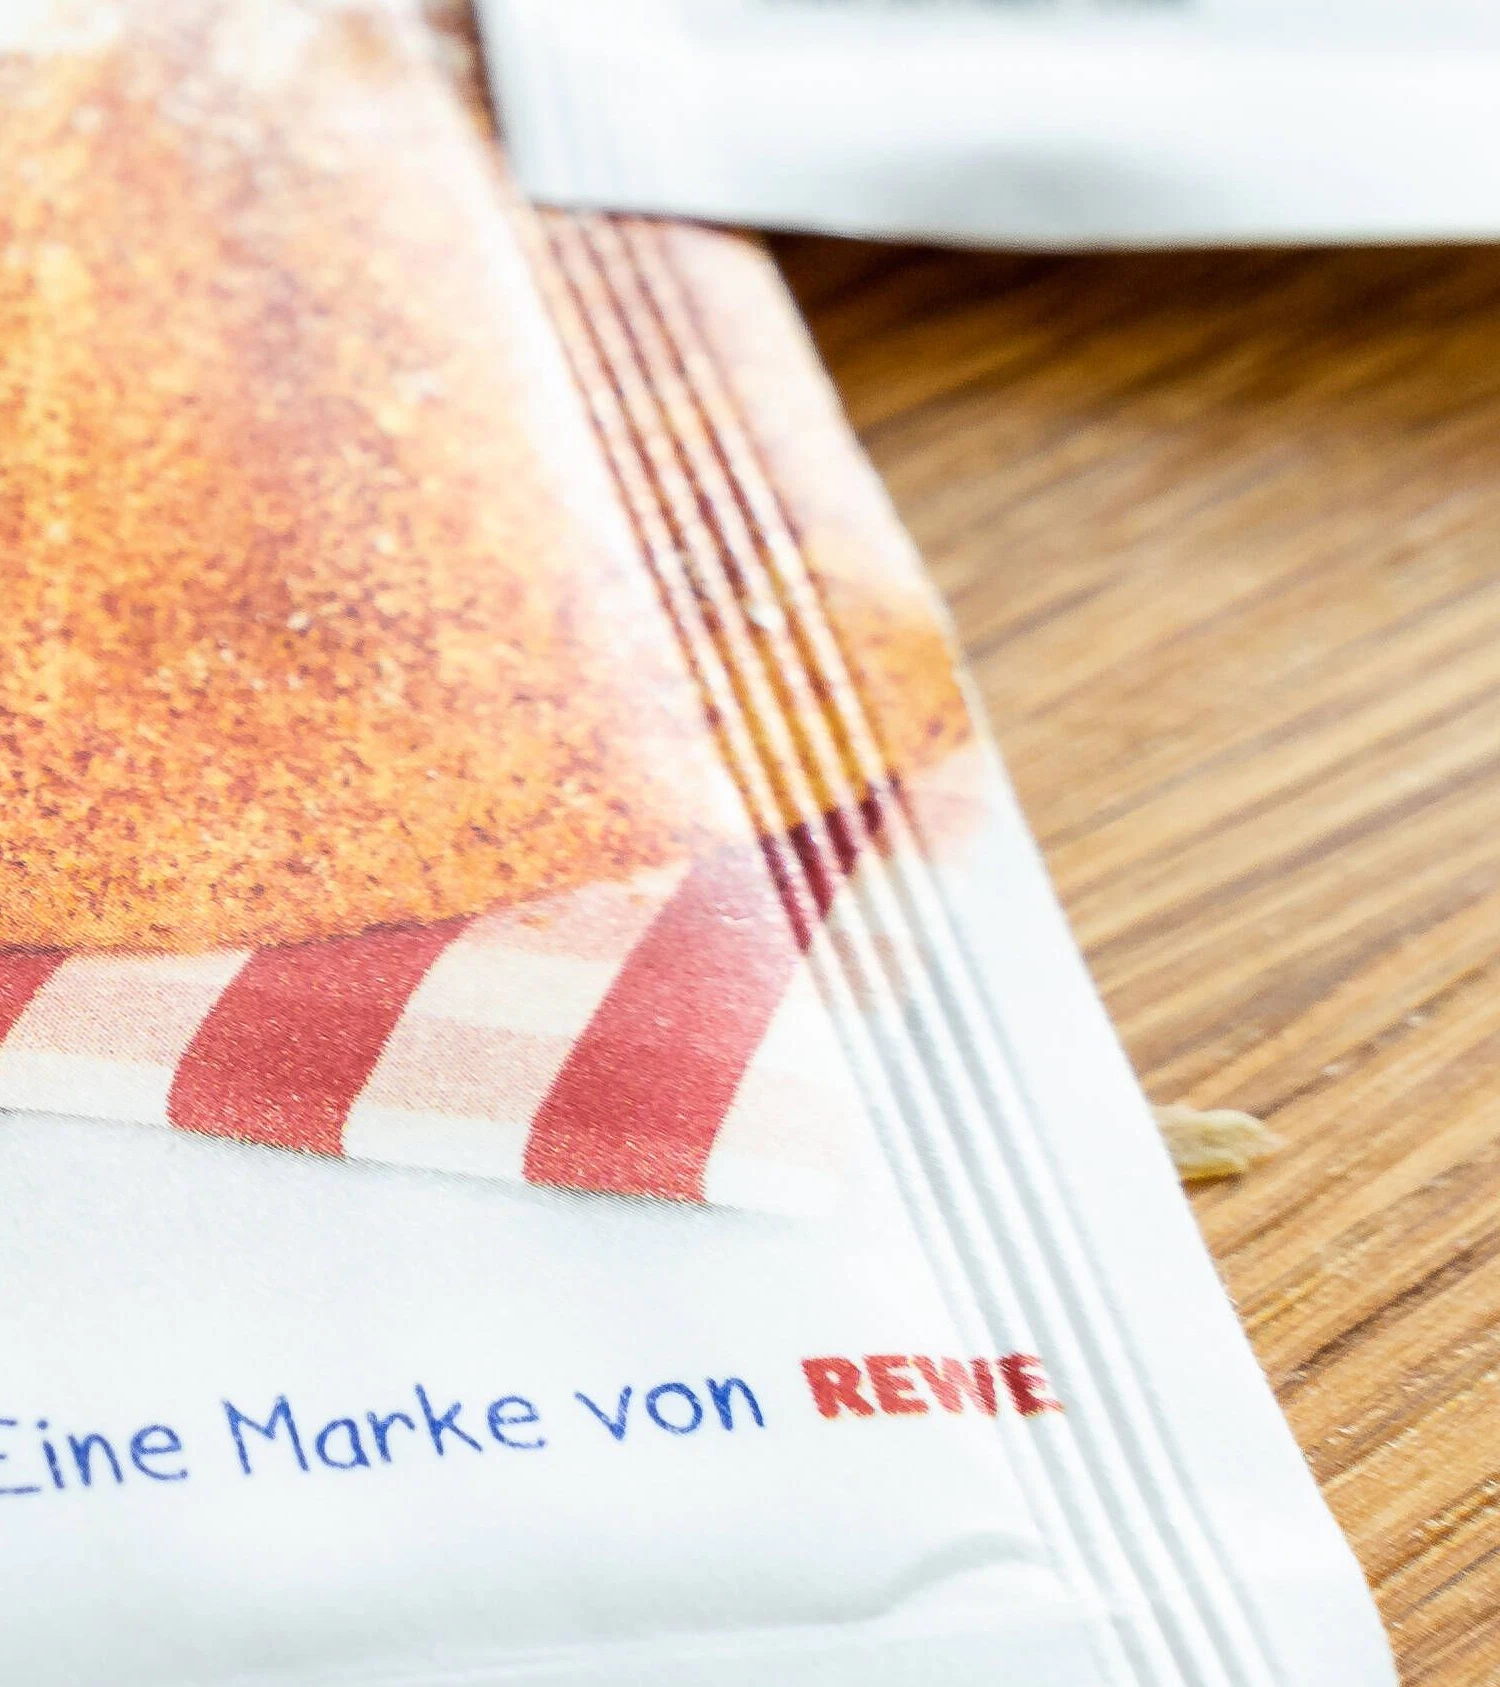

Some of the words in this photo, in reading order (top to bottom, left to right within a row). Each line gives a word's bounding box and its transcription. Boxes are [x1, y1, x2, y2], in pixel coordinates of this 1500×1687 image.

[223, 1382, 547, 1476] Marke
[574, 1373, 766, 1441] von
[800, 1352, 1066, 1420] REWE
